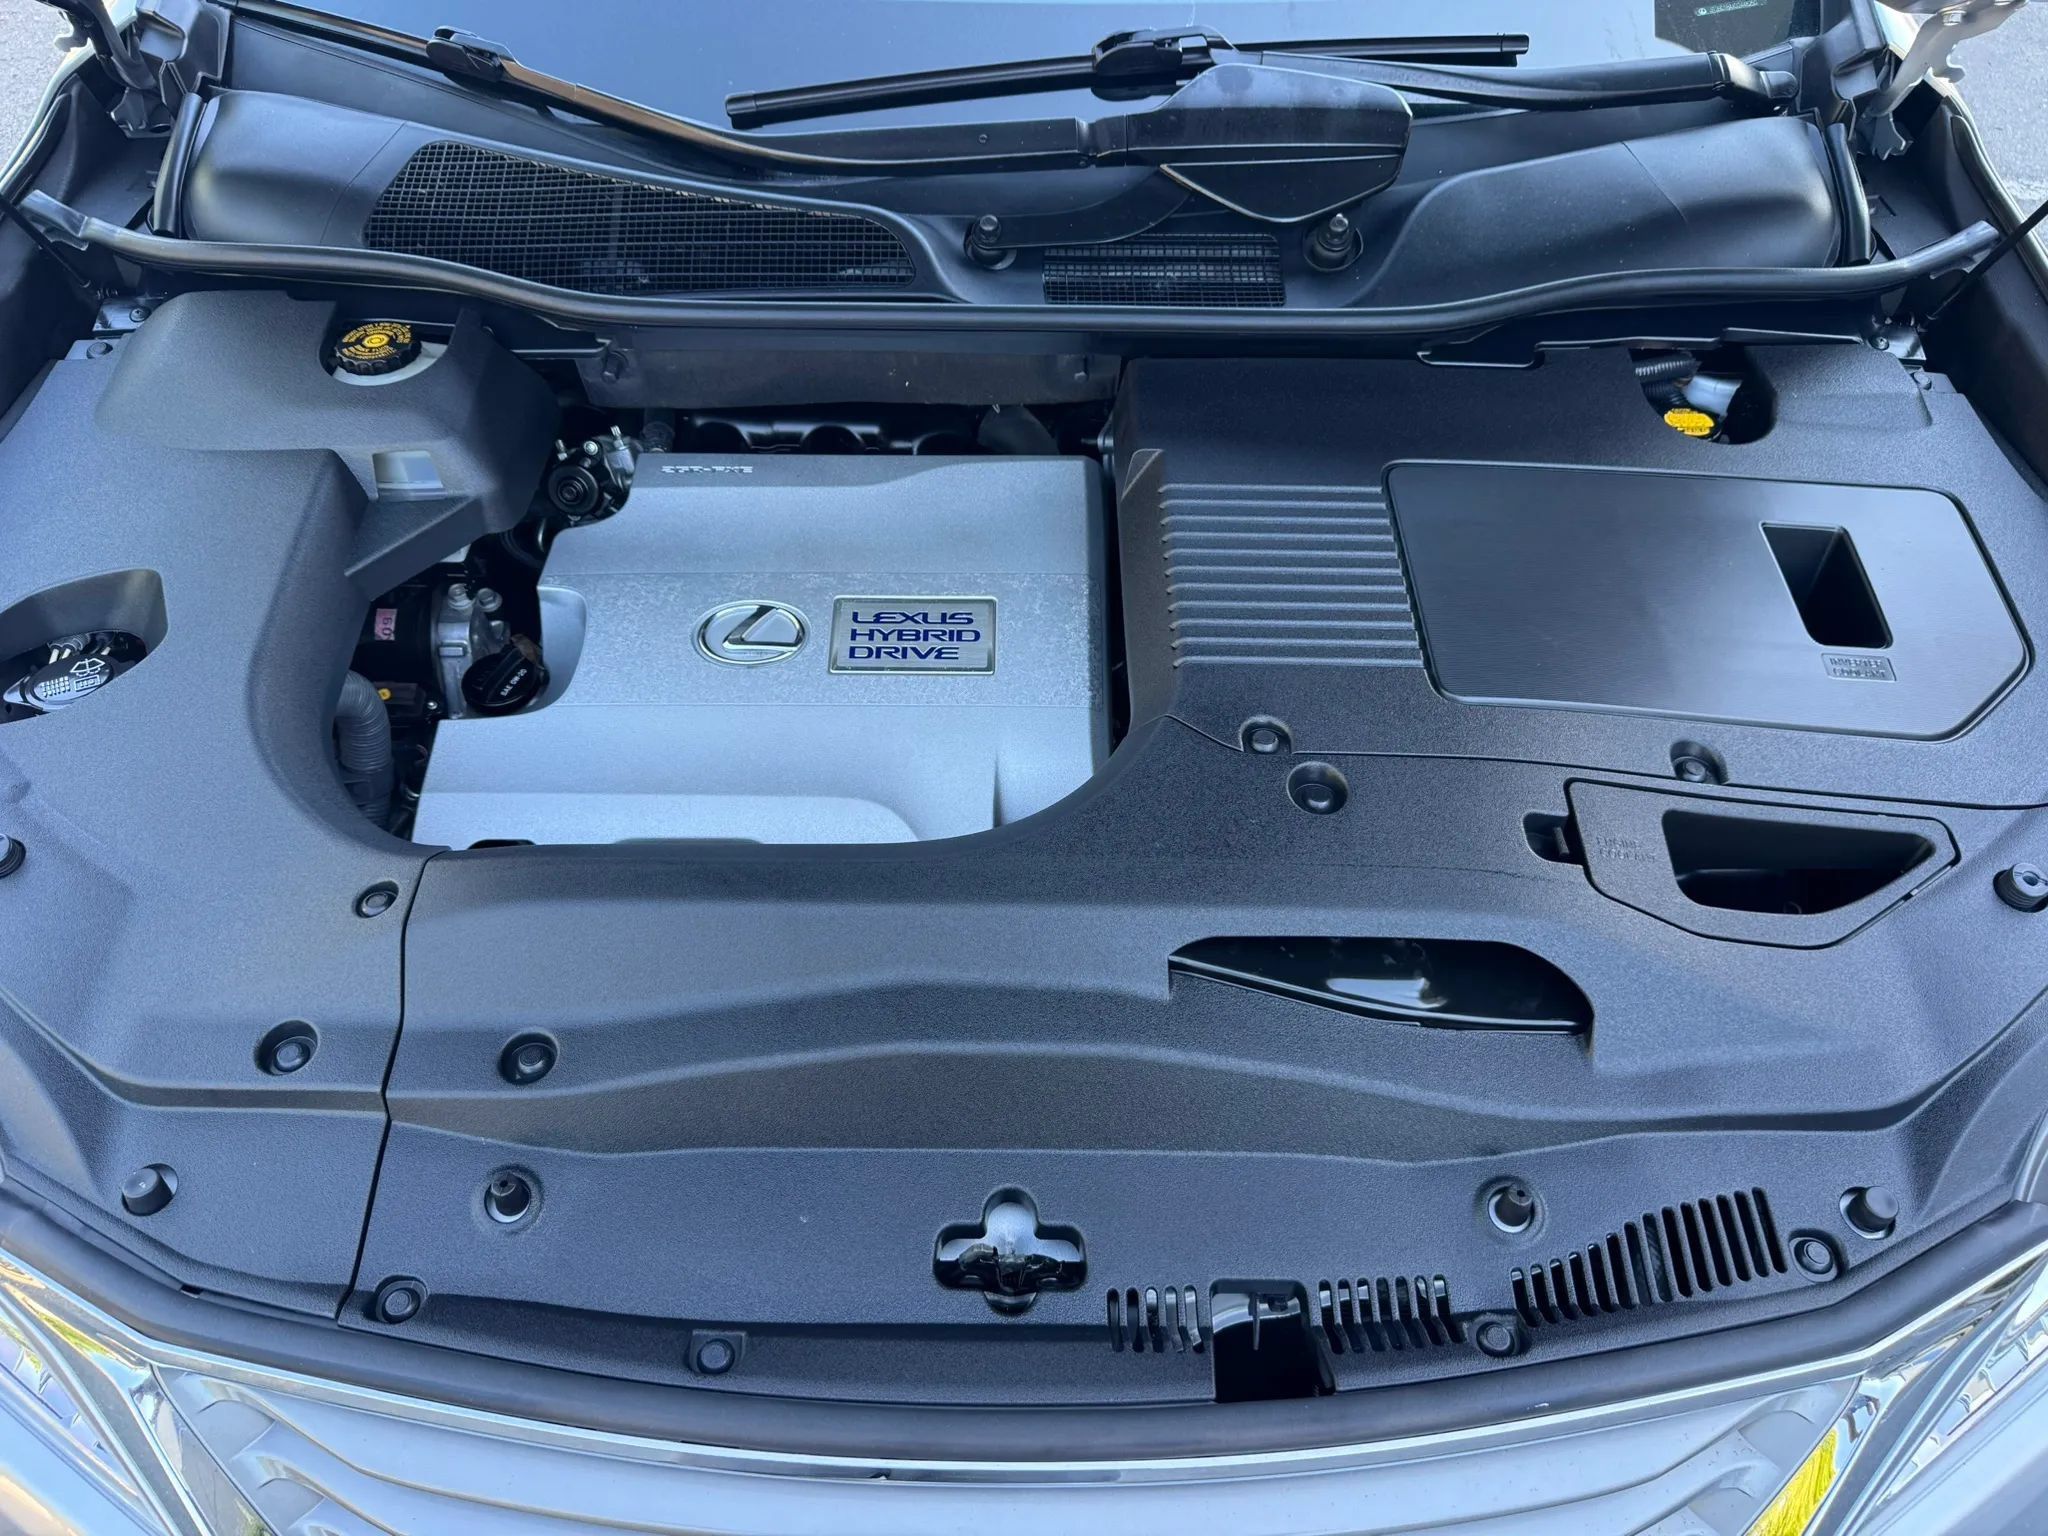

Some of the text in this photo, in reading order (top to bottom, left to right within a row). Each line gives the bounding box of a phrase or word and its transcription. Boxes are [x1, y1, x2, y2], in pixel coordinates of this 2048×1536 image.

[852, 611, 974, 625] LEXUS
[850, 628, 981, 642] HYBRID
[848, 646, 960, 660] DRIVE
[1829, 657, 1882, 667] INVERTER
[1832, 667, 1886, 678] COOLANT
